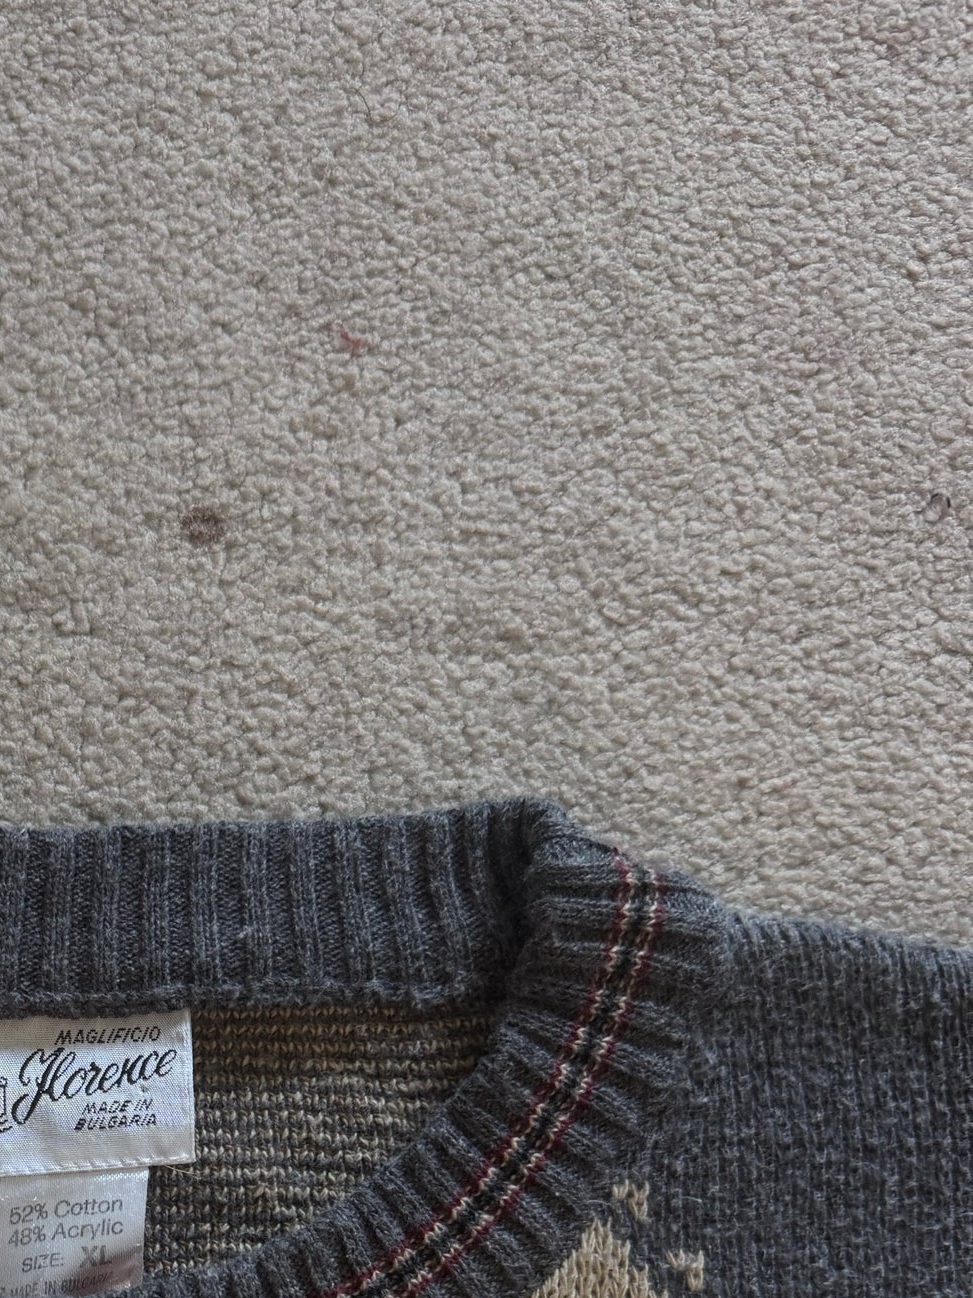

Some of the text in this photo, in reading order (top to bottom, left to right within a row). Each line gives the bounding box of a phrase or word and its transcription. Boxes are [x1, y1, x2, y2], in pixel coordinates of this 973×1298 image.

[54, 1026, 161, 1045] MAGLIFICIO
[11, 1048, 178, 1125] Florence
[81, 1099, 153, 1115] MADE IN
[74, 1114, 158, 1131] BULGARIA
[9, 1199, 123, 1225] 52% Cotton
[8, 1218, 124, 1247] 48% Acrylic
[21, 1245, 112, 1273] SIZE: XL
